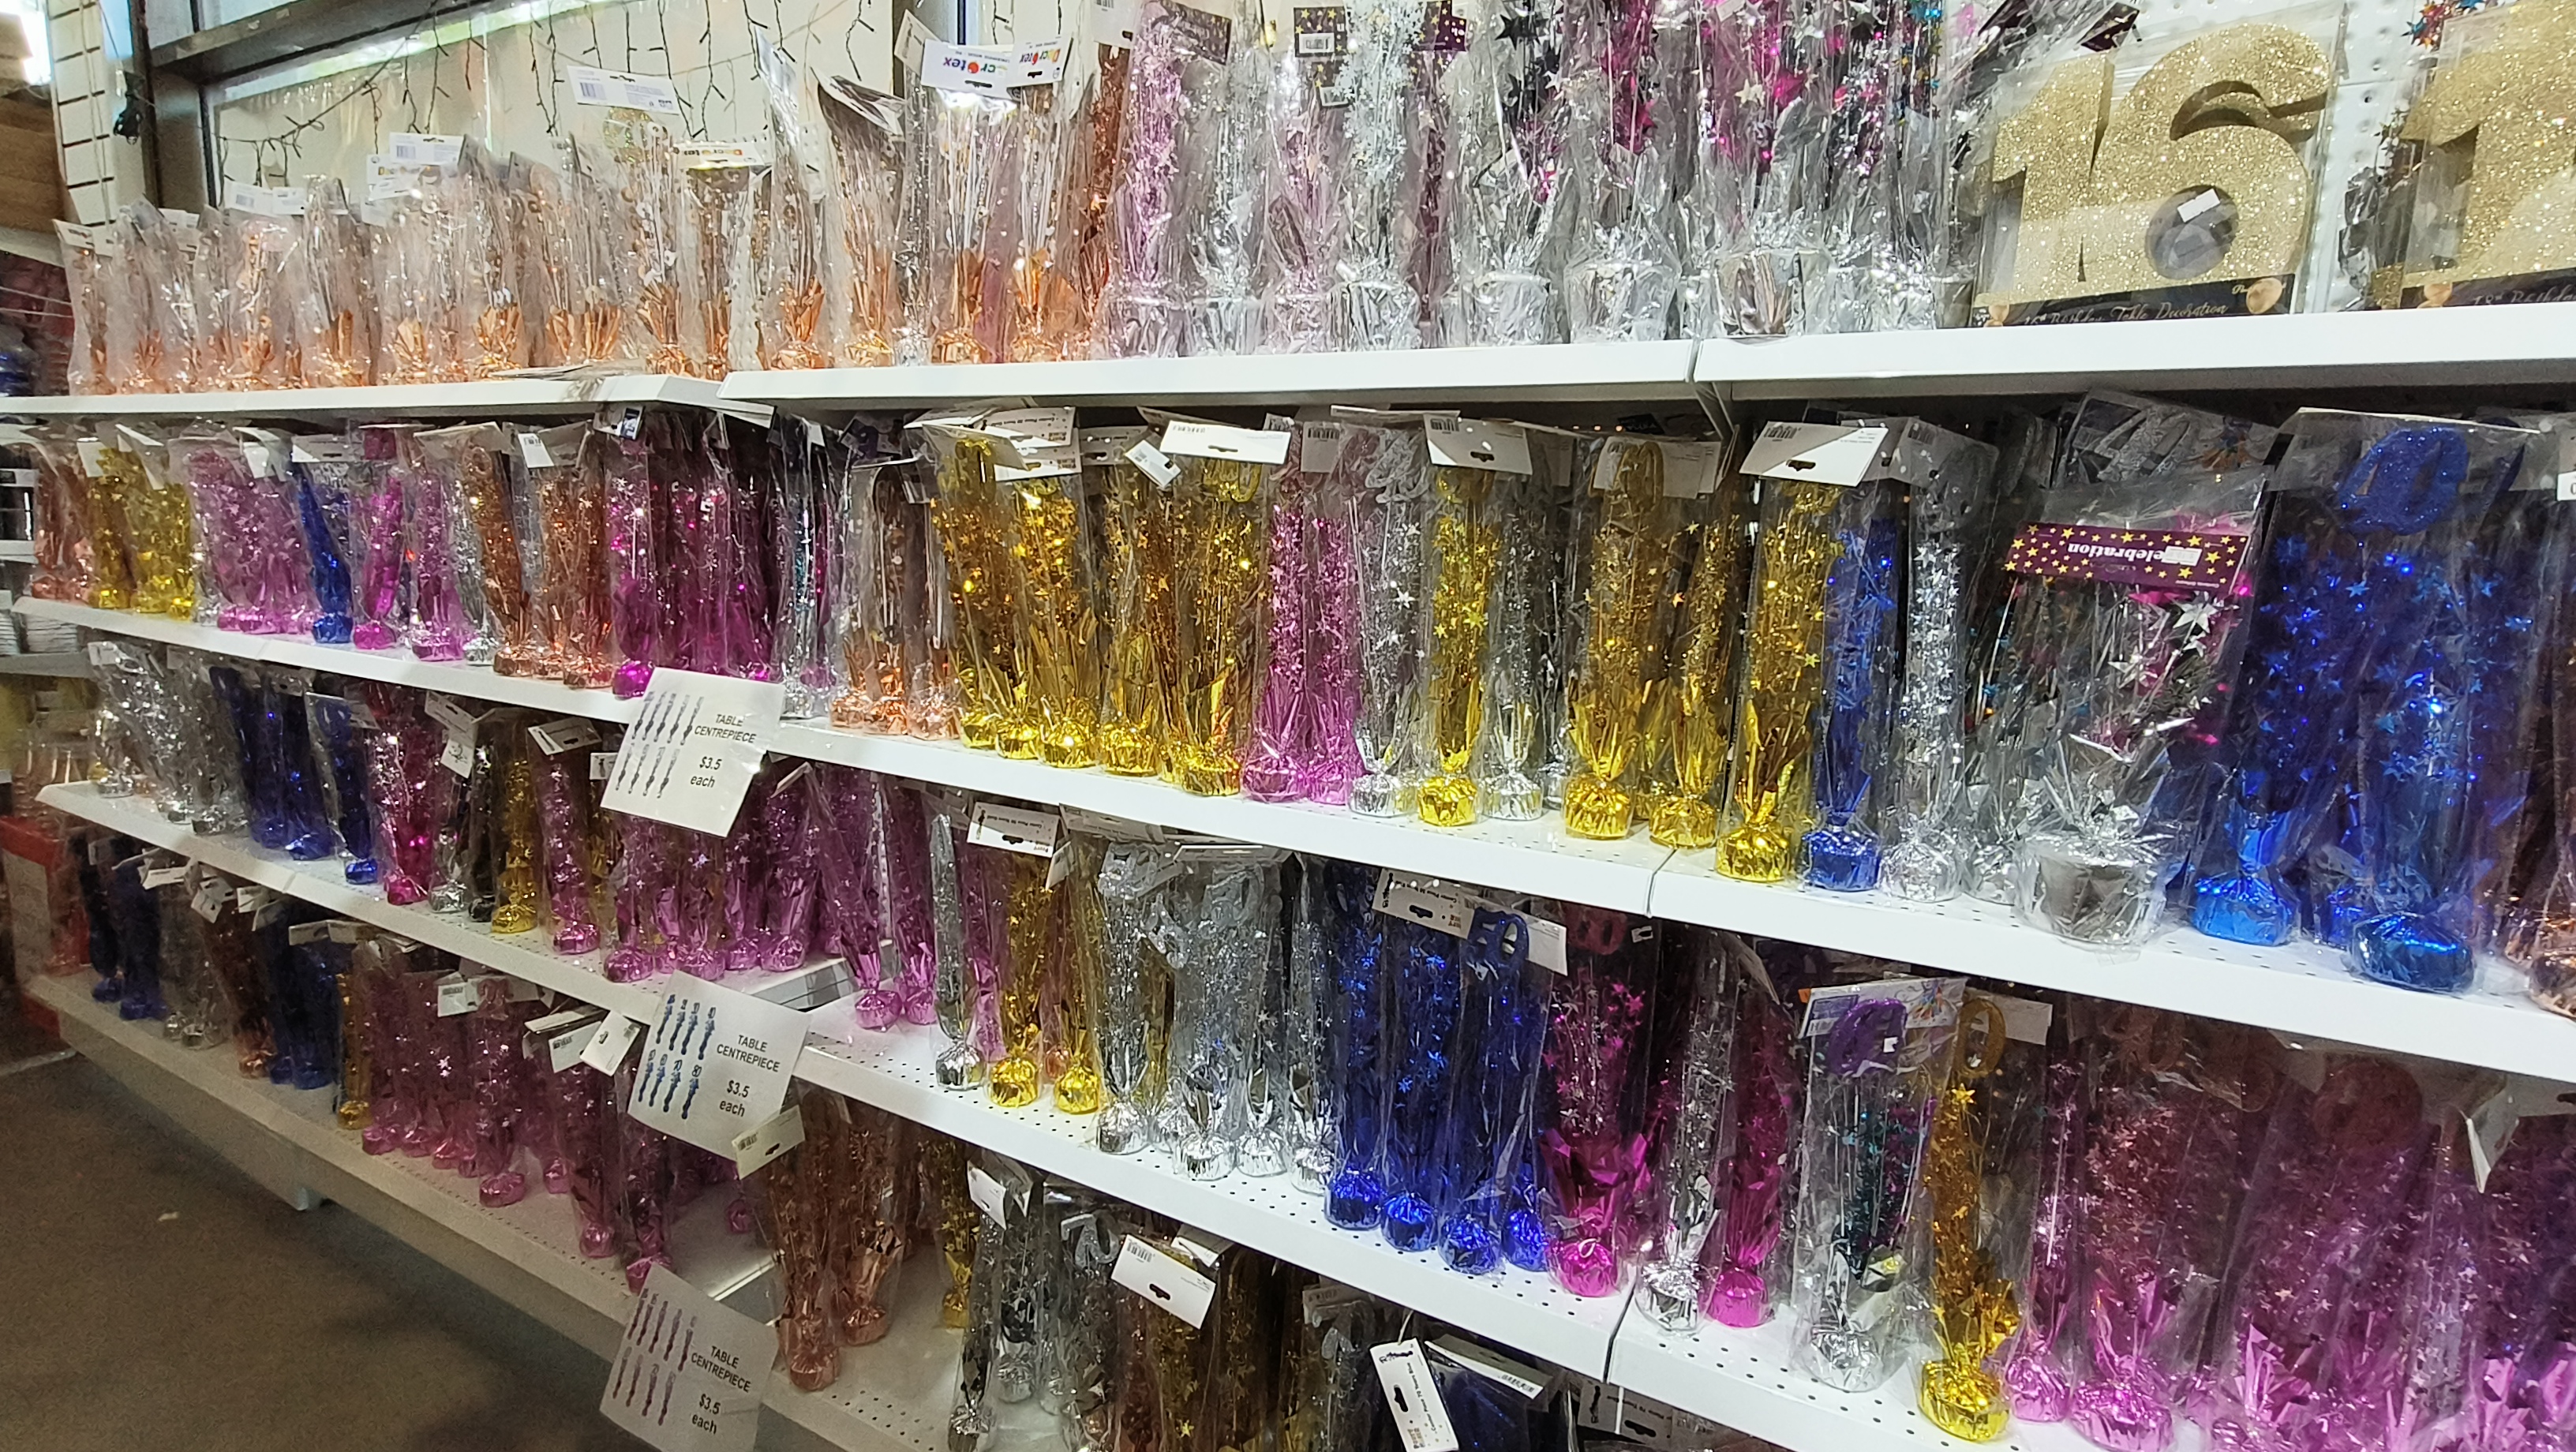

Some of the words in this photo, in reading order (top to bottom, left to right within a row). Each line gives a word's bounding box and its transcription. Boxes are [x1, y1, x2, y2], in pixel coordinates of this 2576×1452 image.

[2068, 542, 2167, 563] elebration
[715, 713, 744, 728] TABLE
[694, 725, 758, 745] CENTREPIECE
[698, 755, 722, 771] $3.5
[690, 775, 716, 789] each
[736, 1034, 769, 1053] TABLE
[716, 1042, 781, 1073] CENTREPIECE
[726, 1079, 750, 1098] $3.5
[719, 1099, 746, 1119] each
[710, 1344, 739, 1370] TABLE
[691, 1352, 751, 1394] CENTREPIECE
[698, 1393, 721, 1416] $3.5
[691, 1412, 717, 1435] each
